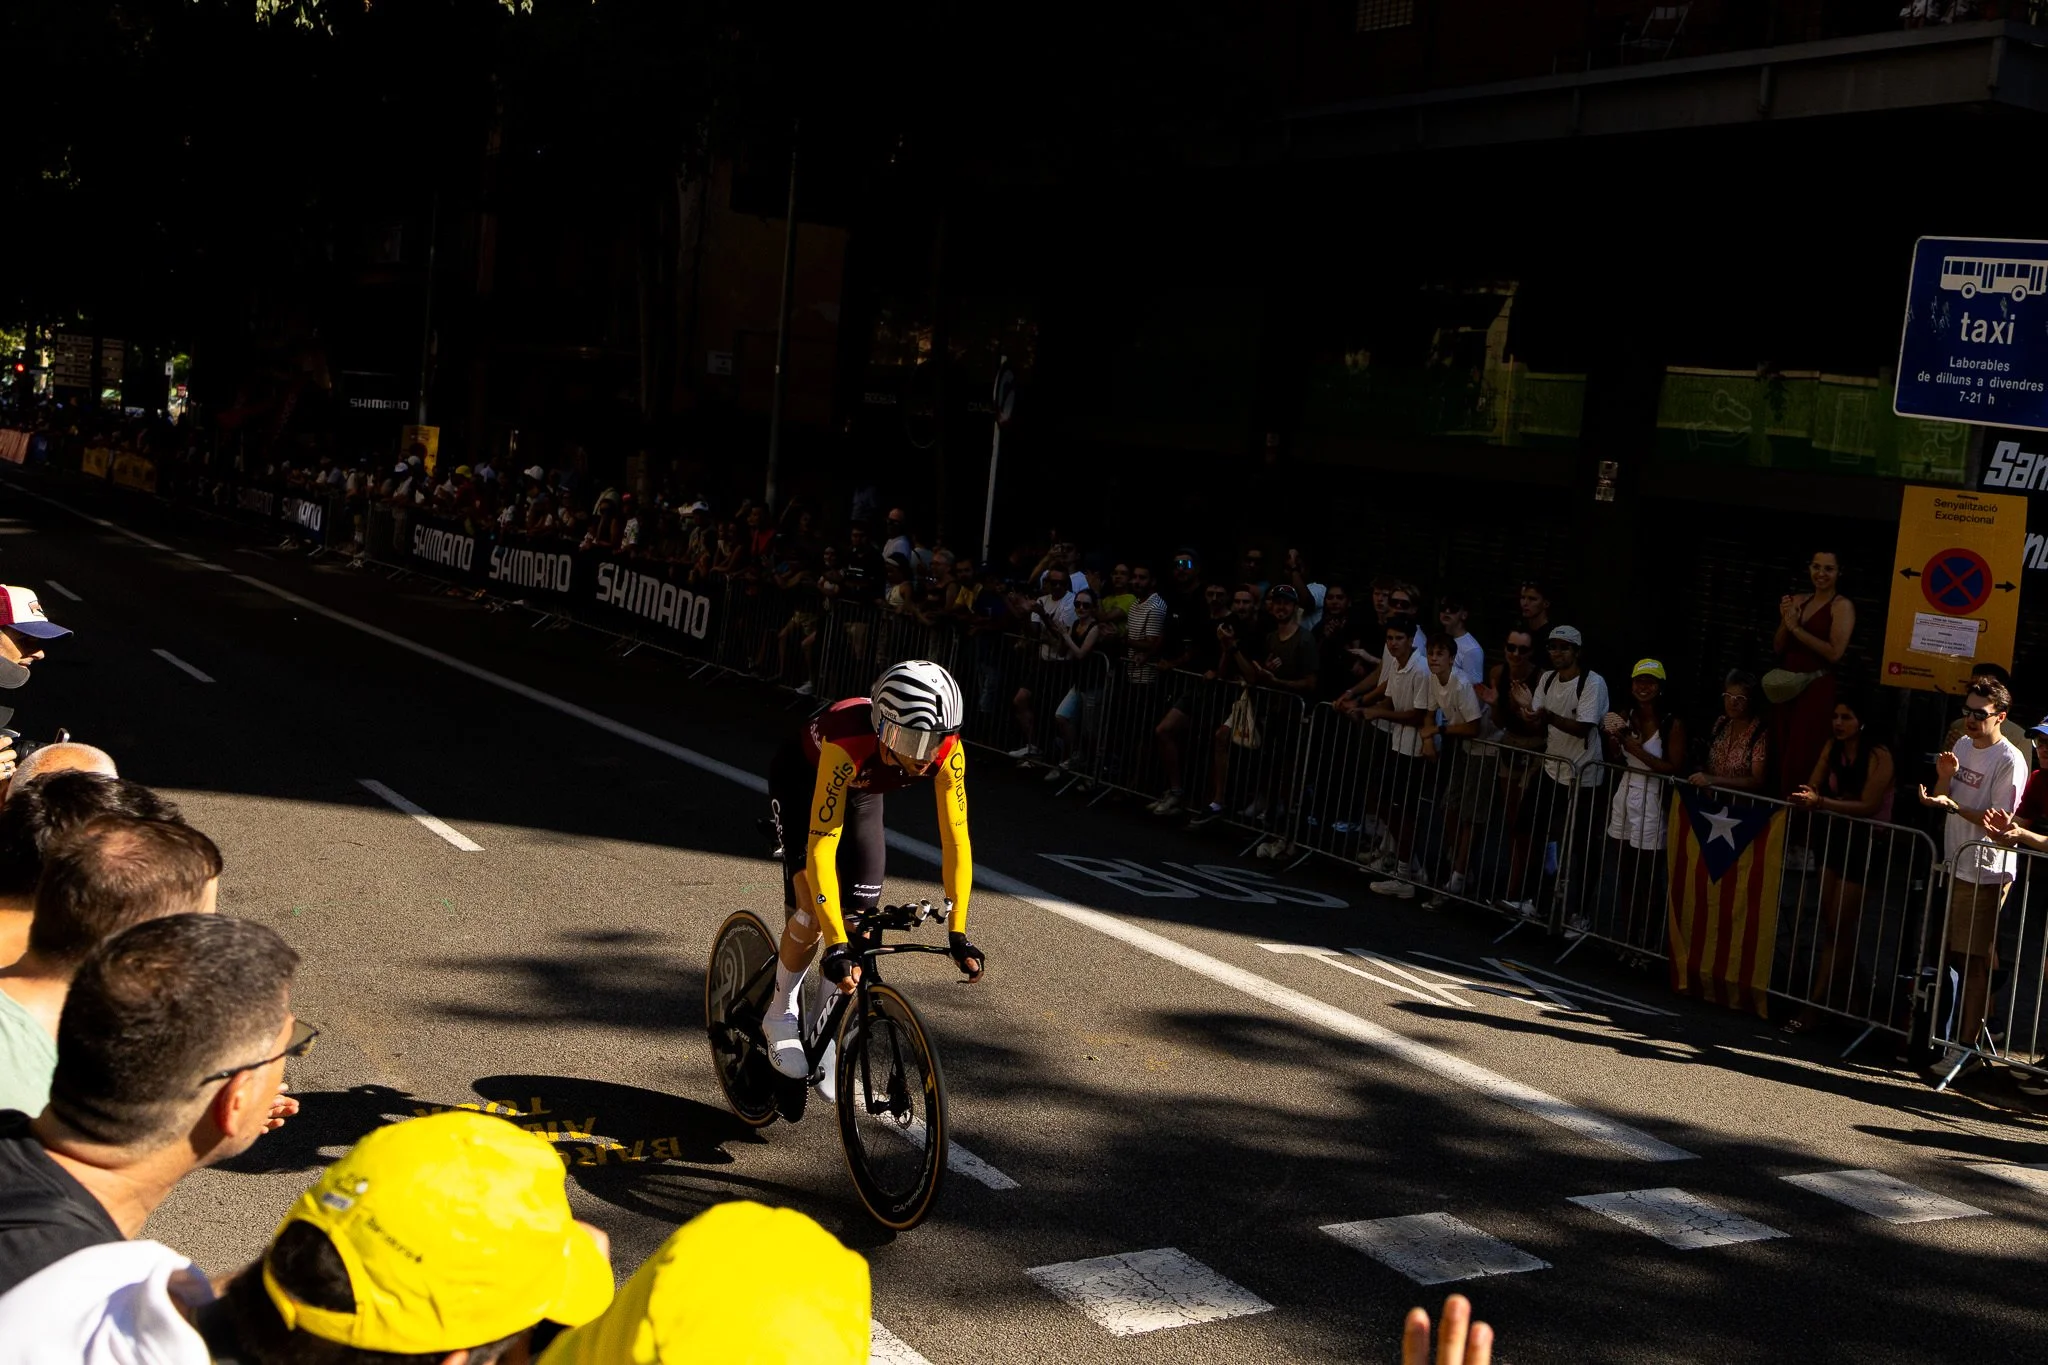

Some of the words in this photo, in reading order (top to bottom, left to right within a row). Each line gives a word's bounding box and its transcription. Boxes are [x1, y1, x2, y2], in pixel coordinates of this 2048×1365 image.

[1960, 311, 2015, 344] taxi
[1917, 371, 1930, 382] de
[1936, 372, 1971, 386] dilluns
[1977, 377, 1984, 387] a
[1989, 377, 2044, 392] divendres
[1950, 356, 2010, 371] Laborables
[349, 397, 409, 410] SHIMANO
[1959, 391, 1981, 404] 7-21
[1988, 394, 1995, 405] h
[1983, 440, 2048, 491] San
[281, 496, 323, 532] SHIMANO
[1934, 498, 1998, 514] Senyalització
[1935, 511, 1995, 525] Excepcional
[412, 524, 475, 572] SHIMANO
[488, 545, 573, 593] SHIMANO
[595, 561, 711, 640] SHIMANO
[819, 762, 854, 823] Cofidis
[809, 830, 837, 838] OOK
[1037, 852, 1350, 910] BUS
[1255, 943, 1682, 1018] TAXI
[810, 987, 843, 1049] LOO
